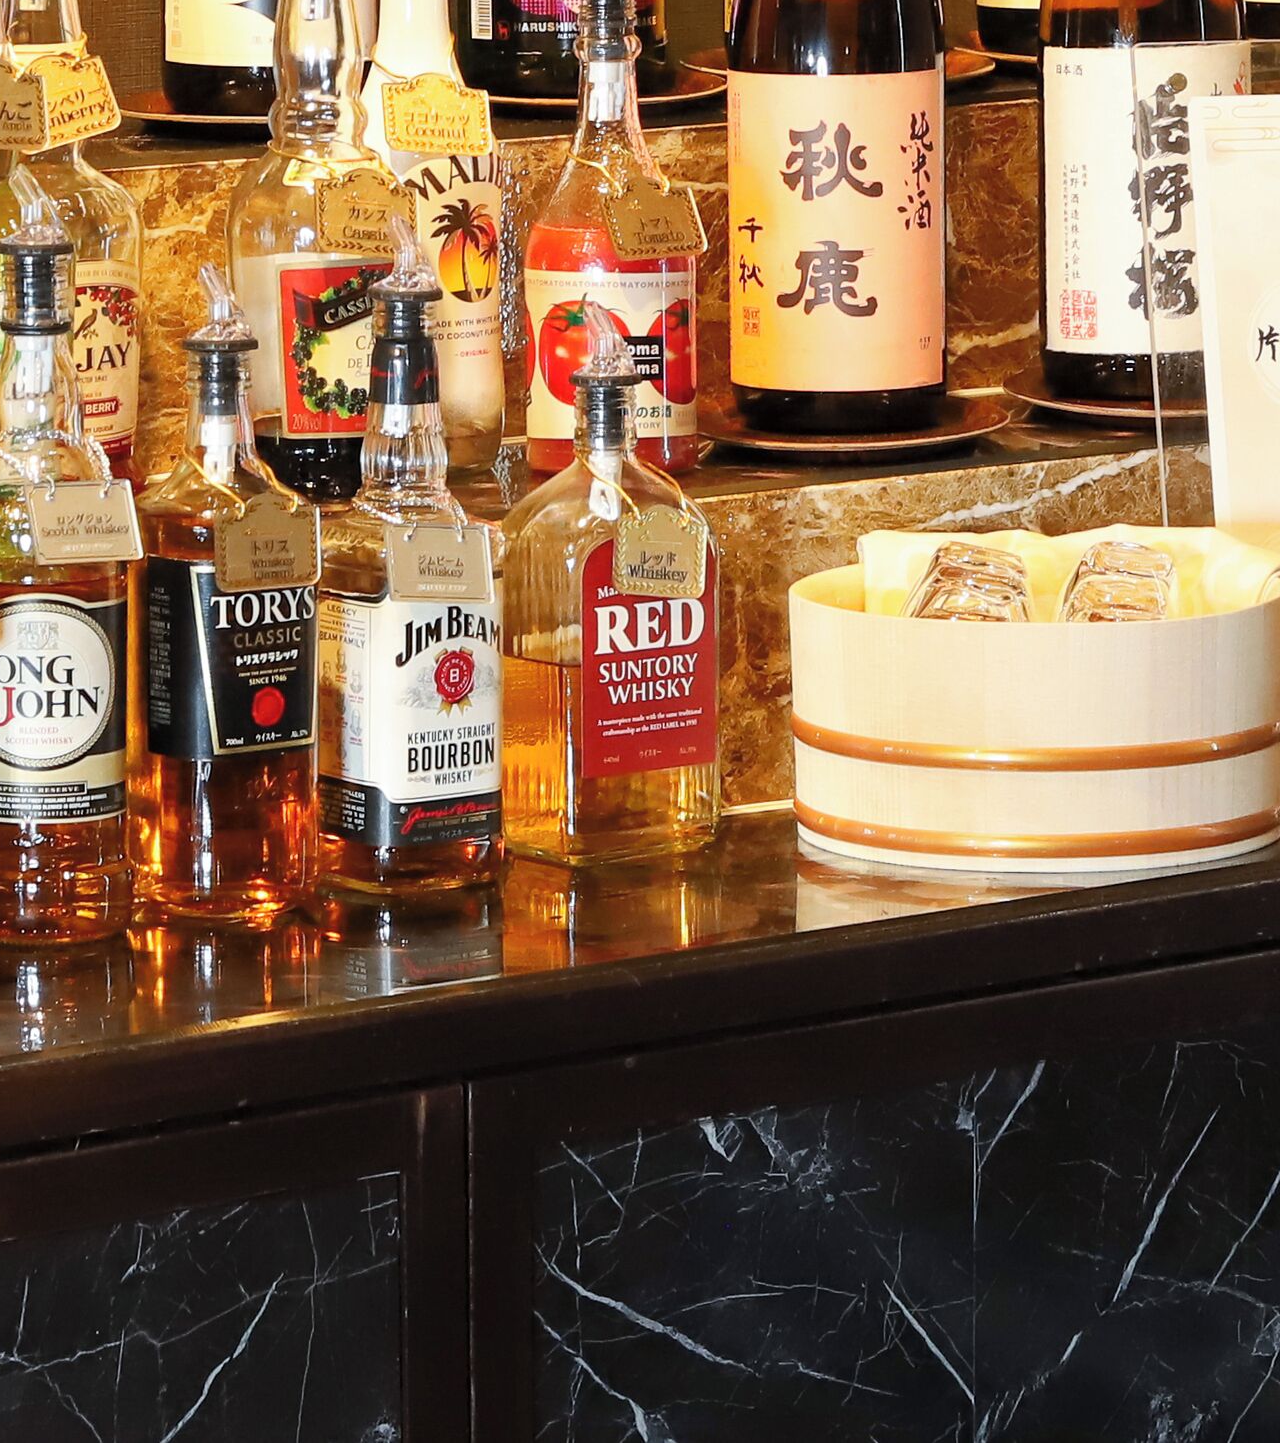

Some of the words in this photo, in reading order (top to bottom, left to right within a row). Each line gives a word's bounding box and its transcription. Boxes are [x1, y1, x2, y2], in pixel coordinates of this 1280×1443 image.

[1055, 64, 1083, 76] 日本酒
[403, 110, 471, 126] ココナッツ
[2, 122, 33, 133] Apple
[404, 124, 467, 139] Coconut
[897, 110, 934, 231] 純米酒
[347, 206, 388, 222] カシス
[776, 120, 884, 318] 秋鹿
[1070, 164, 1081, 280] 山野酒造株式会社
[639, 216, 673, 232] トマト
[633, 231, 685, 245] Tomato
[737, 217, 766, 293] 千秋
[76, 343, 132, 373] JAY
[85, 399, 119, 416] BERRY
[57, 513, 113, 526] ロングジョン
[41, 526, 80, 537] Scotch
[84, 524, 131, 536] Whiskey
[251, 539, 289, 554] トリス
[640, 550, 678, 567] レッド
[418, 566, 464, 579] Whiskey
[627, 563, 689, 583] Whiskey
[210, 585, 317, 630] TORYS
[593, 598, 707, 657] RED
[233, 626, 302, 650] CLASSIC
[395, 616, 443, 668] JIM
[447, 605, 502, 653] BEAM
[598, 652, 699, 685] SUNTORY
[607, 675, 696, 707] WHISKY
[407, 728, 454, 745] KENTUCKY
[456, 722, 496, 741] STRAIGHT
[407, 737, 496, 773] BOURBON
[434, 770, 474, 786] WHISKEY
[38, 785, 81, 794] RESERVE
